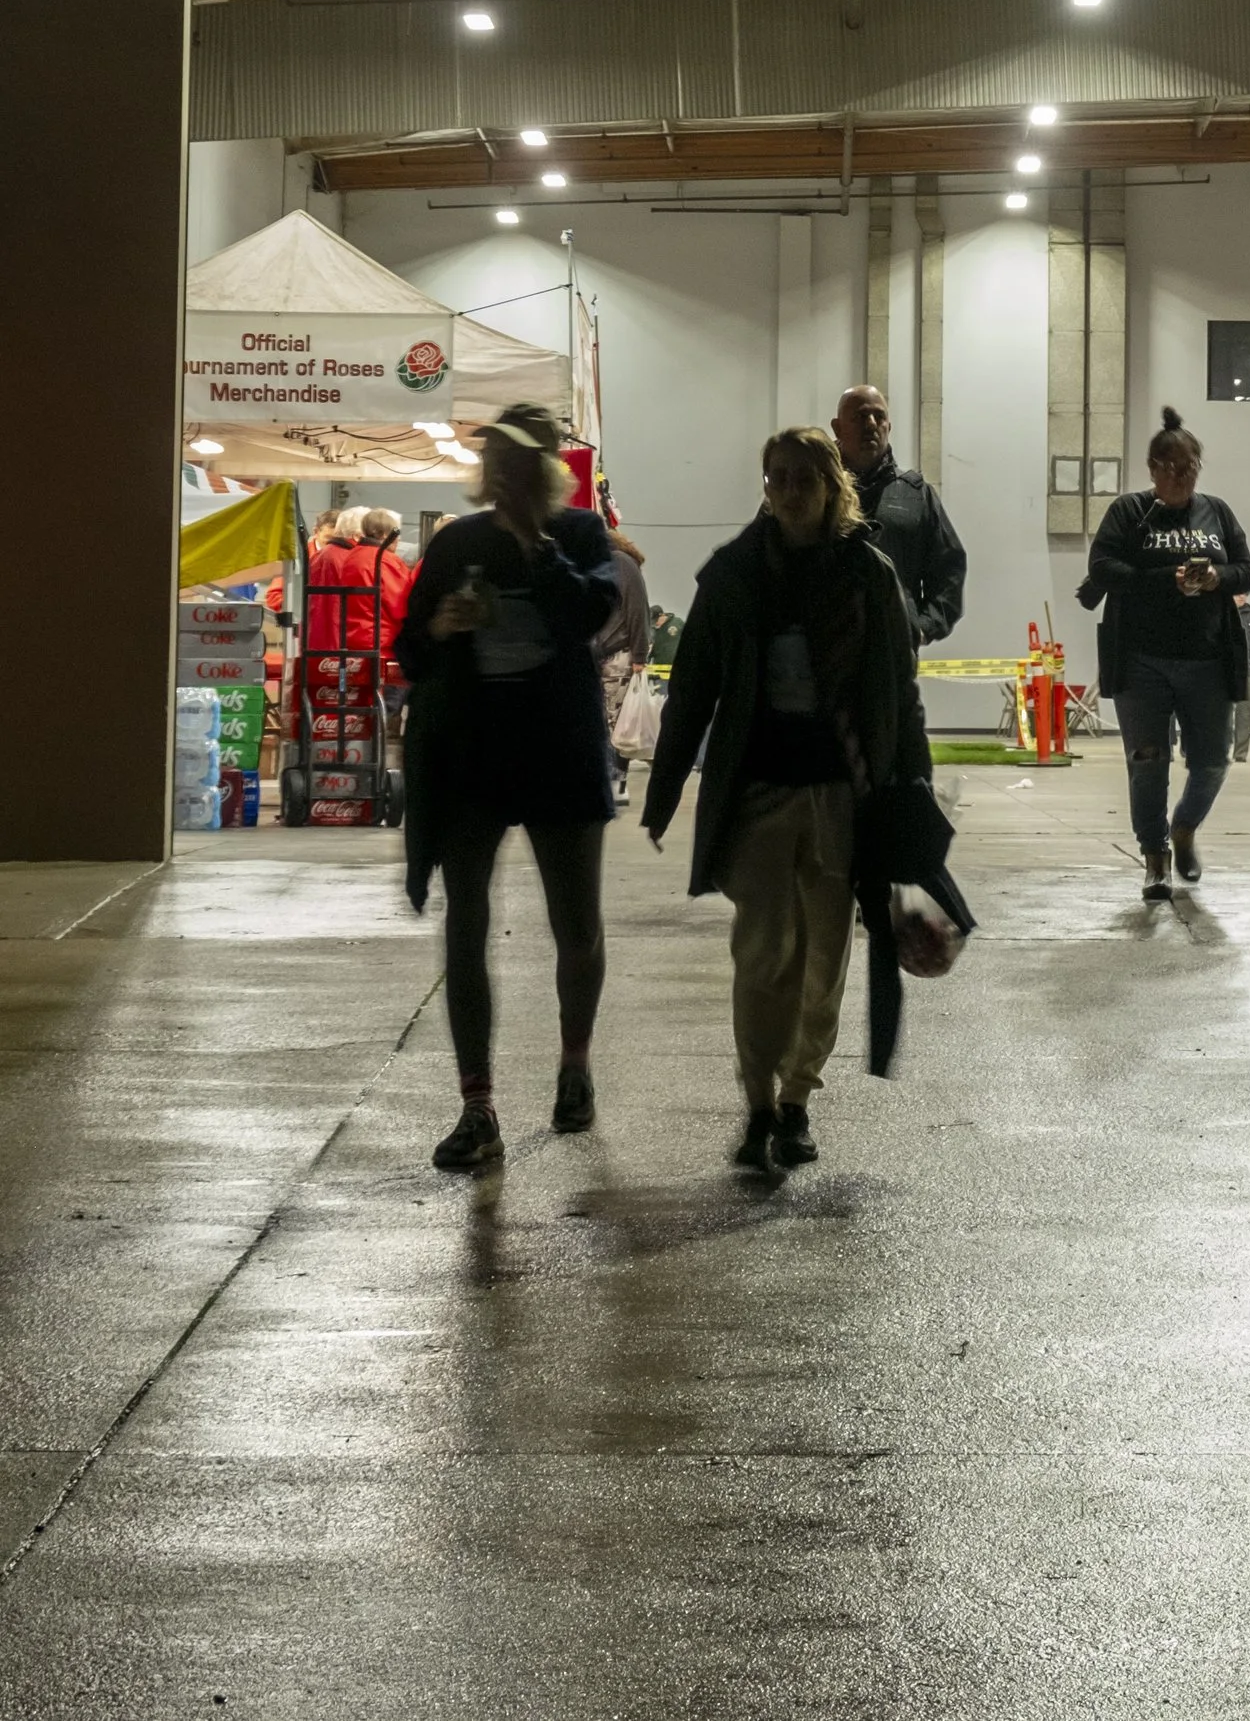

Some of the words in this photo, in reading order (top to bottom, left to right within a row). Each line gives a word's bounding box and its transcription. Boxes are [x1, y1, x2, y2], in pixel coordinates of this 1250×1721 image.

[241, 333, 311, 352] Official
[296, 359, 316, 376] of
[323, 359, 385, 377] Roses
[210, 383, 341, 403] Merchandise
[1142, 533, 1222, 551] CHIEFS
[192, 606, 238, 623] Coke
[196, 662, 243, 679] Coke
